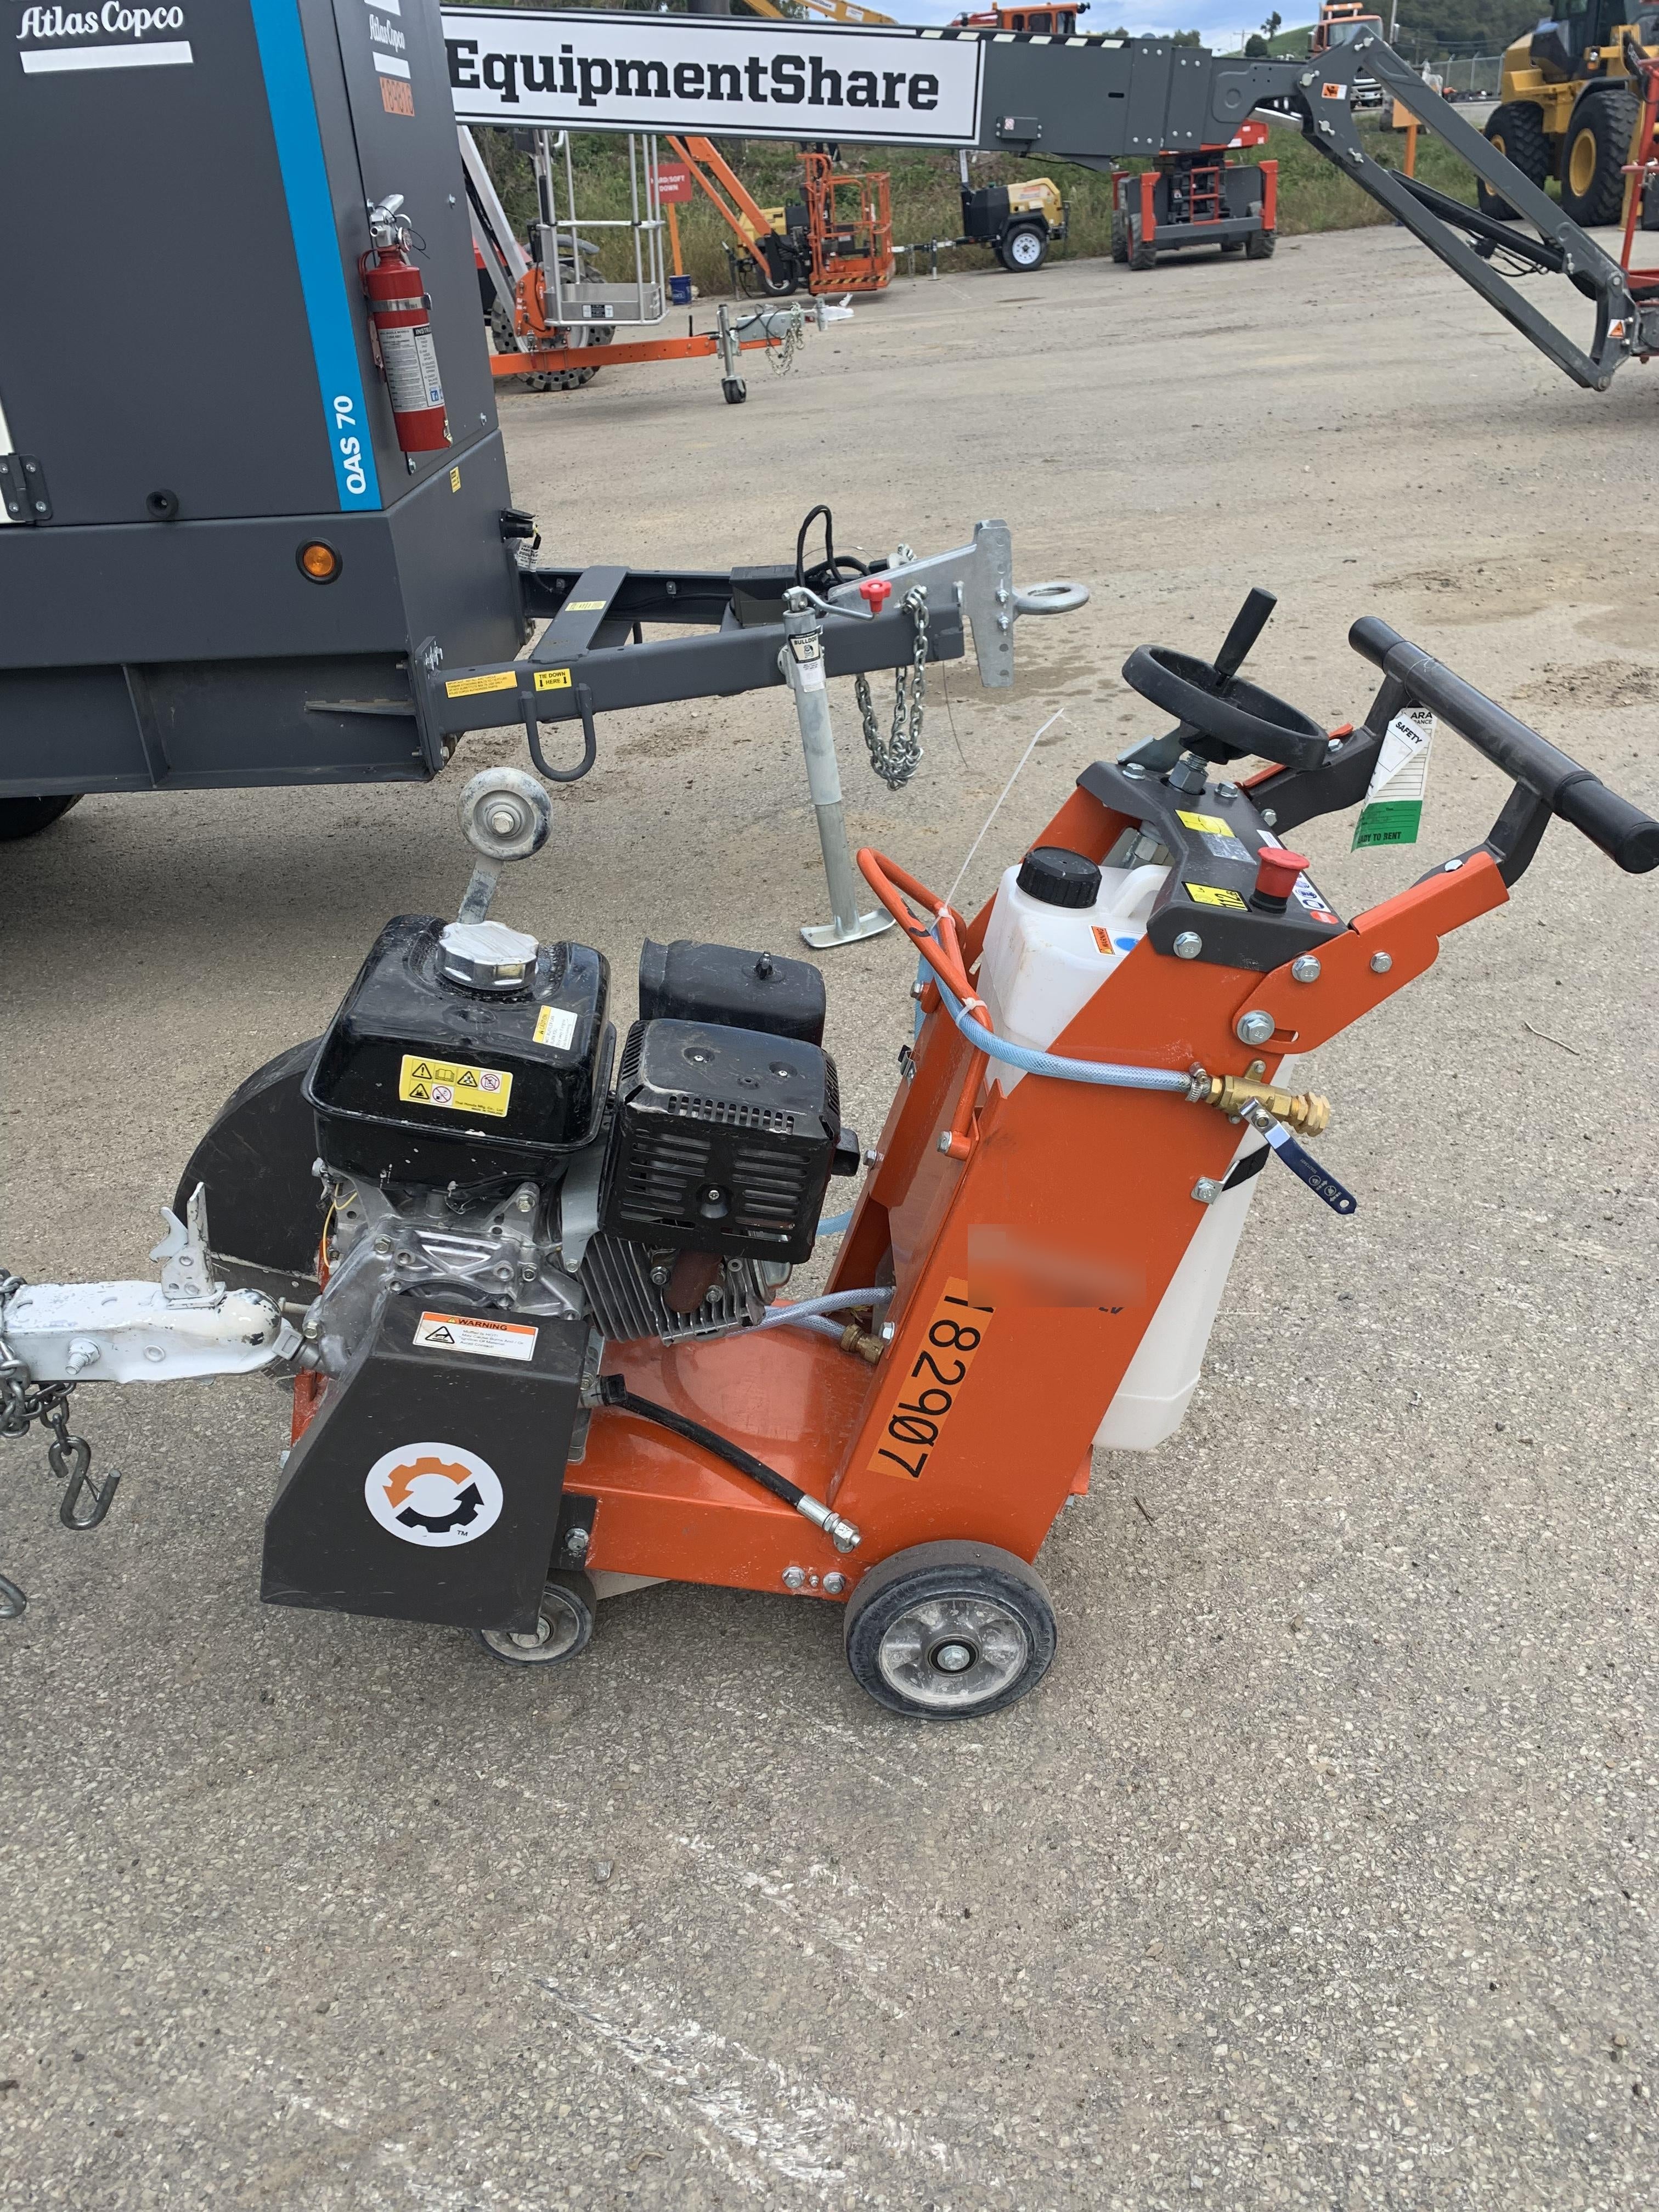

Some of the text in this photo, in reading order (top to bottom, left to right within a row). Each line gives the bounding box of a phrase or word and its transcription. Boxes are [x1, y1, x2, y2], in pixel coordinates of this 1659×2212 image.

[15, 1, 184, 39] Atlas Copco
[369, 14, 406, 53] Atlas Copco
[445, 38, 939, 110] EquipmentShare
[333, 395, 366, 494] QAS 70
[1395, 721, 1423, 744] SAFETY
[1373, 833, 1381, 841] TO
[1383, 831, 1402, 840] RENT
[1214, 893, 1246, 909] 112
[1096, 928, 1109, 948] WARNING
[539, 1013, 548, 1029] CAUTION
[458, 1319, 507, 1330] WARNING
[878, 1295, 995, 1479] 182907
